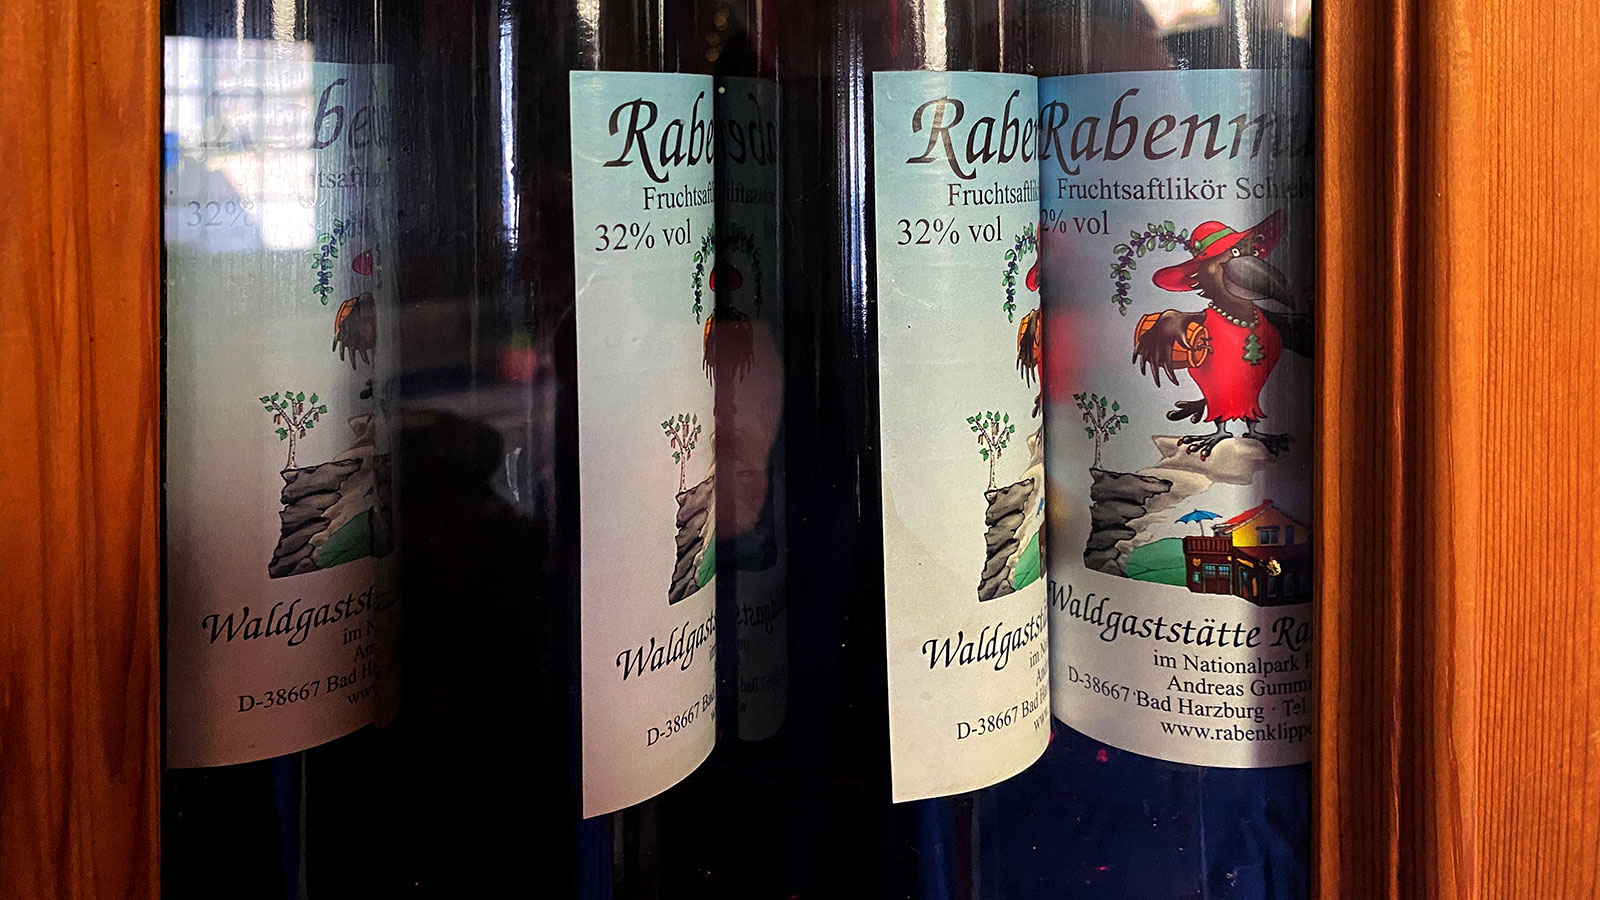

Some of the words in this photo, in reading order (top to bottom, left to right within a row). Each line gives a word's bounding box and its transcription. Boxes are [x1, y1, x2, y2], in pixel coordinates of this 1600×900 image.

[1057, 177, 1226, 200] Fruchtsaftlikör
[595, 222, 655, 251] 32%
[663, 217, 691, 246] vol
[897, 217, 960, 246] 32%
[968, 216, 1002, 242] vol
[1073, 211, 1109, 235] vol
[1049, 580, 1260, 648] Waldgaststätte
[342, 628, 361, 645] im
[1153, 650, 1177, 669] im
[1182, 654, 1299, 677] Nationalpark
[238, 681, 319, 713] D-38667
[327, 668, 357, 694] Bad
[1068, 665, 1129, 702] D-38667
[1136, 689, 1171, 713] Bad
[1178, 699, 1264, 723] Harzburg
[1166, 675, 1244, 696] Andreas
[647, 701, 699, 747] D-38667
[957, 706, 1018, 740] D-38667
[1022, 695, 1038, 718] Bad
